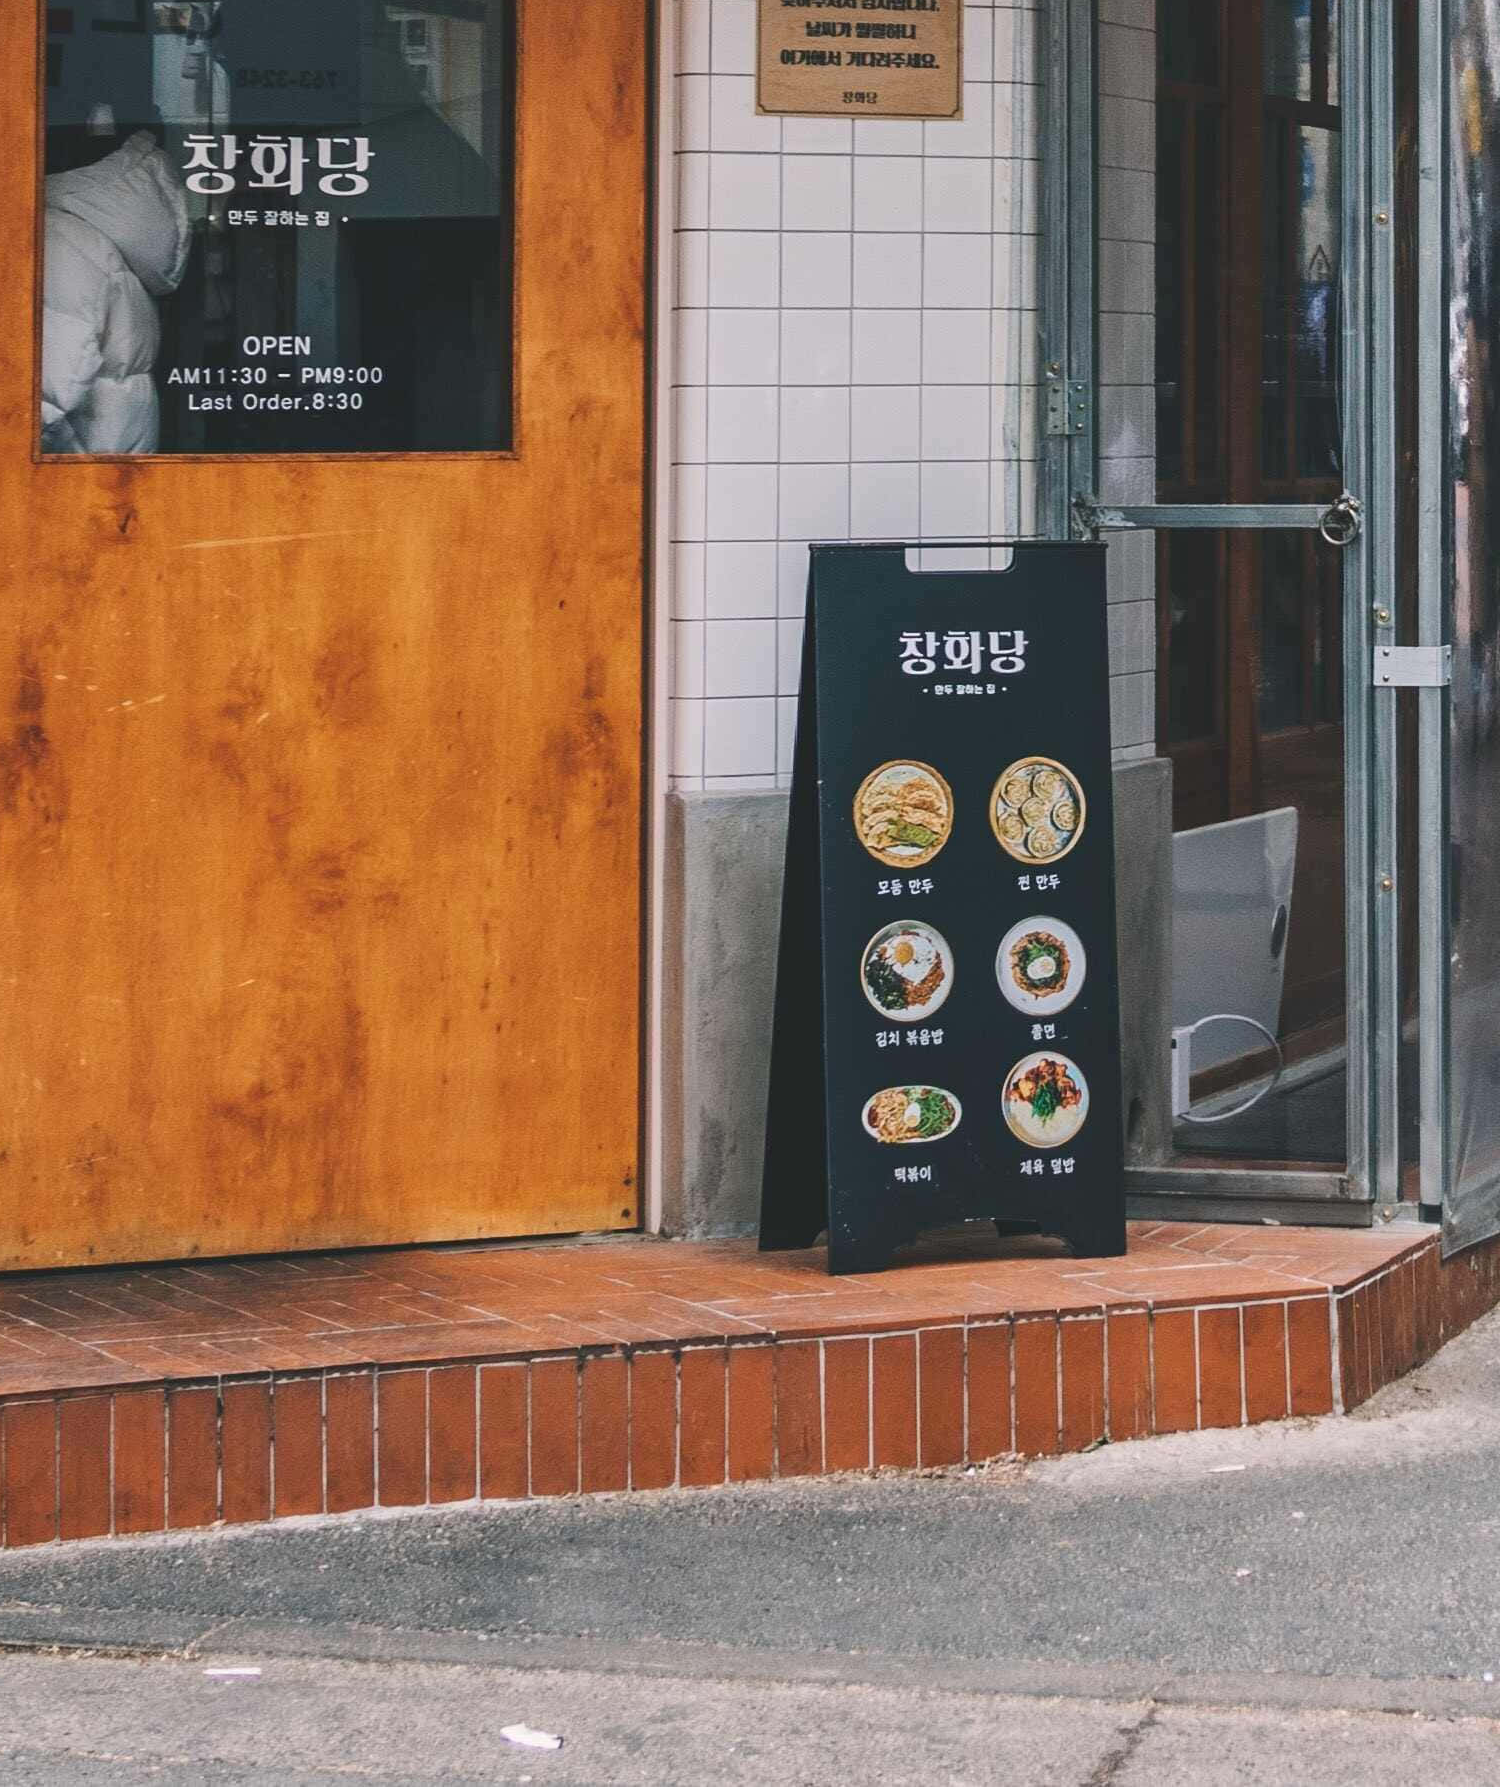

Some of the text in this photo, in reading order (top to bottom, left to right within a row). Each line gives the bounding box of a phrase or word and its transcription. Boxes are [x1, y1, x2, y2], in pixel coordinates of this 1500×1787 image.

[181, 133, 376, 197] 창화당
[227, 210, 331, 226] 만두 잘하는 집
[242, 335, 312, 356] OPEN
[167, 367, 268, 385] AM11:30
[301, 367, 384, 385] PM9:00
[188, 393, 233, 411] Last
[898, 630, 1030, 676] 창화당
[934, 683, 997, 696] 만두 잘하는 집
[908, 878, 935, 896] 만두
[1035, 873, 1062, 891] 만두
[875, 1028, 945, 1048] 김치 볶음밥
[1030, 1023, 1057, 1041] 쫄면
[893, 1164, 933, 1183] 떡볶이
[1019, 1156, 1077, 1176] 제육 덮밥
